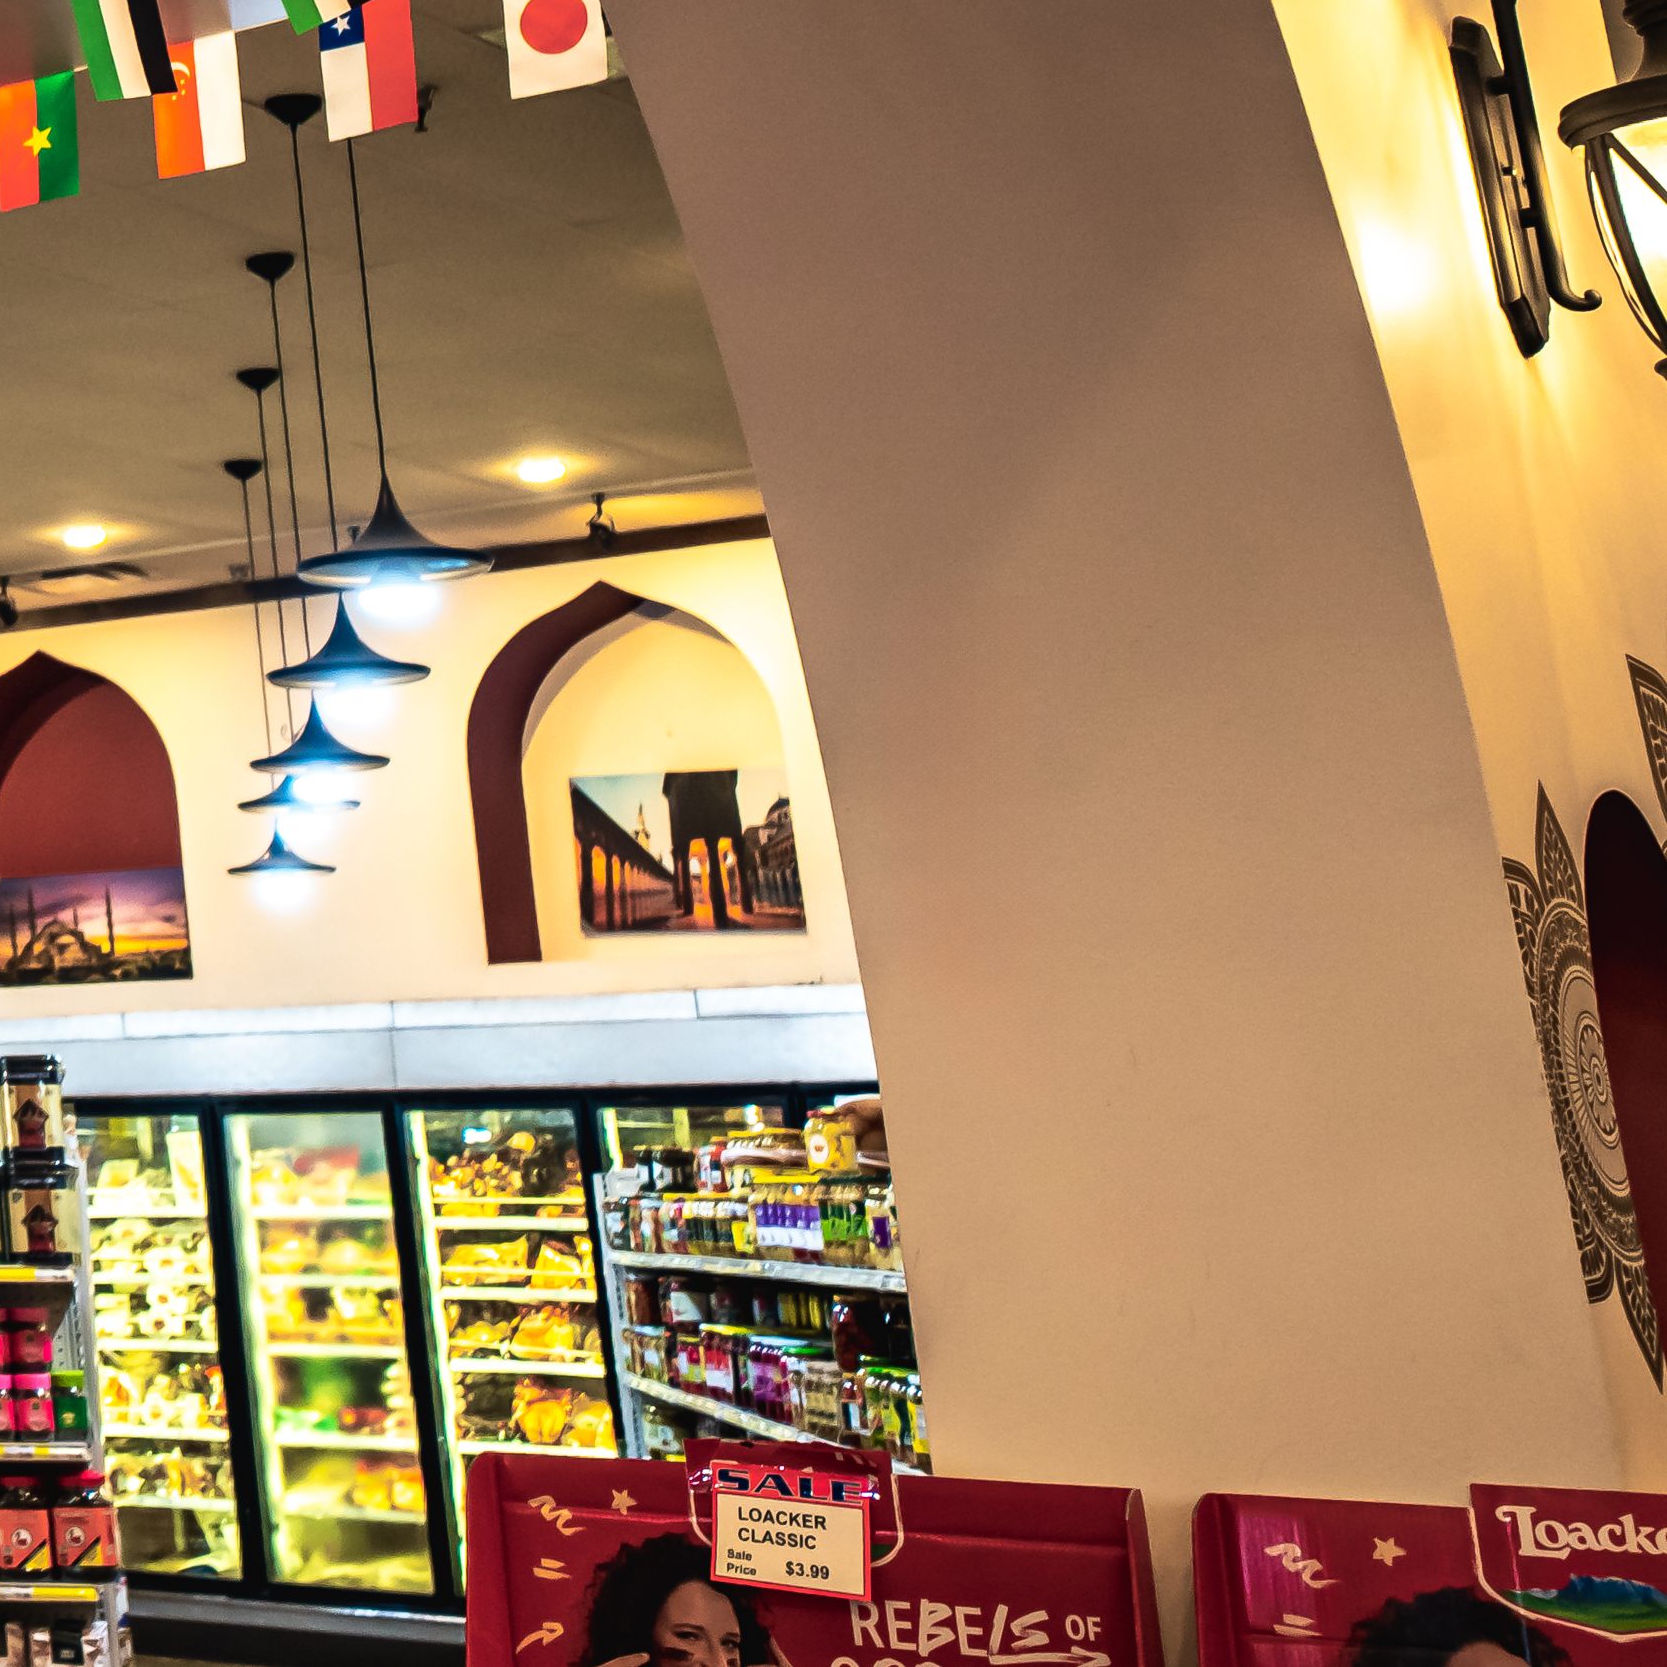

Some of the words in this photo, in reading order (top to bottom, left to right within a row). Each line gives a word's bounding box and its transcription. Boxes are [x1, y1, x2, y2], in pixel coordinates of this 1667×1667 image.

[716, 1467, 863, 1506] SALE
[738, 1506, 828, 1531] LOACKER
[738, 1527, 817, 1550] CLASSIC
[727, 1549, 753, 1562] Sale
[726, 1562, 757, 1576] Price
[785, 1560, 830, 1580] $3.99
[849, 1598, 1050, 1658] REBELS
[1065, 1614, 1103, 1642] OF
